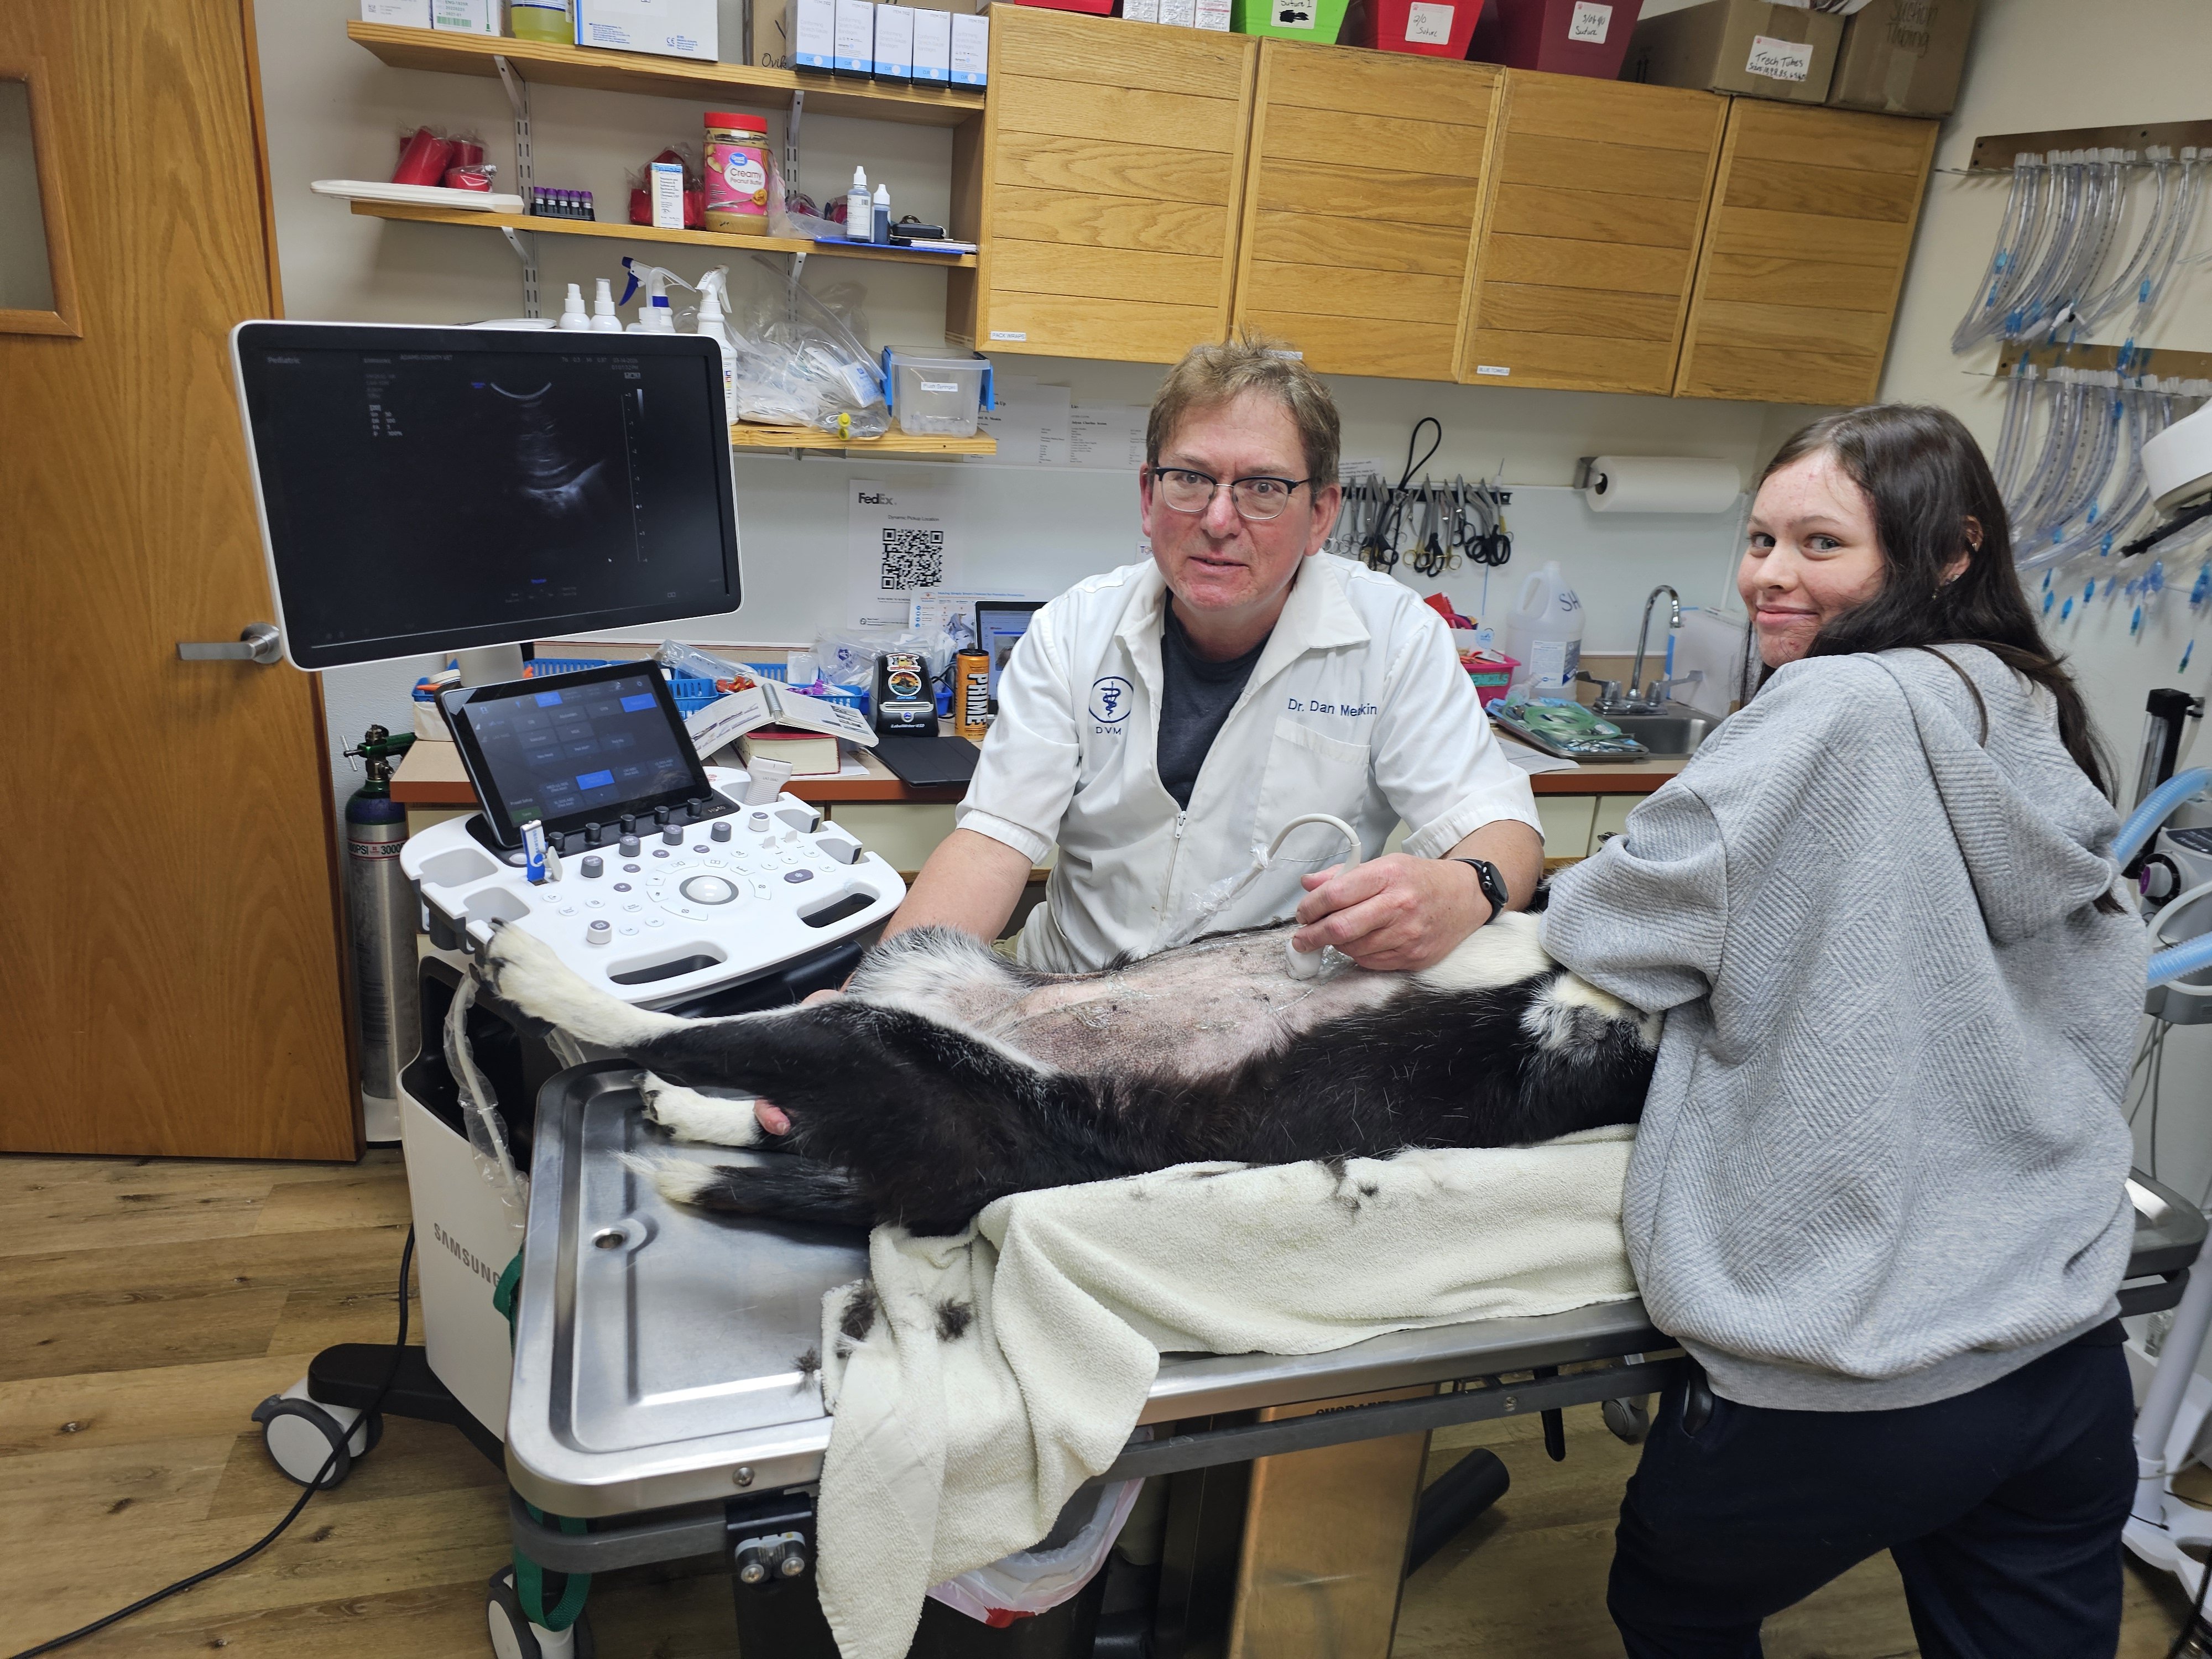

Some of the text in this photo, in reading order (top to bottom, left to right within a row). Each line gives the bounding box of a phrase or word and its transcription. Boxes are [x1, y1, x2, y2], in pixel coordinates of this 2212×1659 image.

[1885, 22, 1930, 58] Tubing
[1781, 56, 1803, 67] Tubes
[730, 168, 762, 180] Creamy
[858, 492, 894, 505] FedEx
[966, 672, 989, 726] PRIME
[1288, 698, 1305, 712] Dr.
[1310, 700, 1335, 714] Dan
[1096, 726, 1121, 735] DVM
[532, 830, 540, 853] SAMSUNG
[434, 1222, 500, 1288] SAMSUNG
